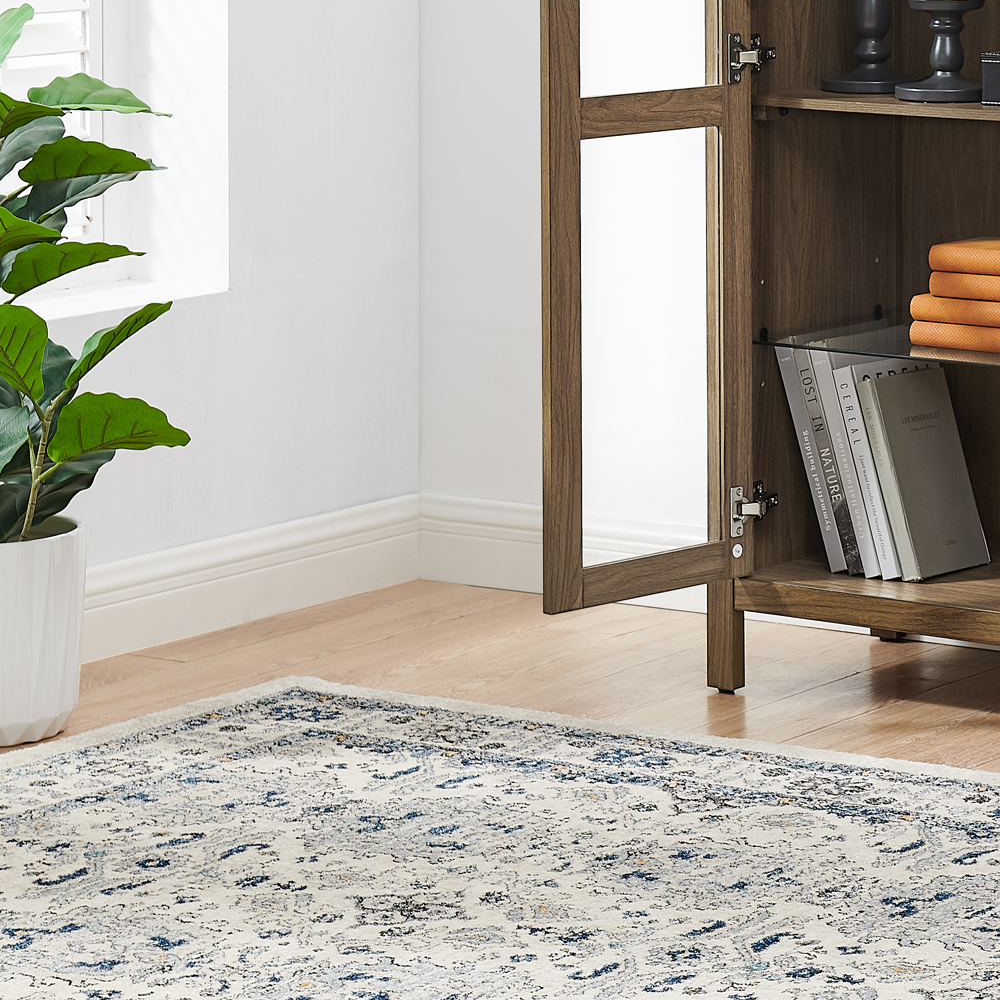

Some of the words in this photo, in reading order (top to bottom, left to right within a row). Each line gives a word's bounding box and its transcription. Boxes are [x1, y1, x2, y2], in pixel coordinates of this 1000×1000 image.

[800, 368, 818, 403] LOST
[812, 415, 825, 432] IN
[820, 448, 842, 503] NATURE
[901, 416, 911, 425] LES
[812, 473, 831, 531] Symmetrical
[836, 432, 858, 507] Hallucinations
[840, 383, 861, 445] CEREAL
[867, 490, 875, 508] collect
[874, 517, 884, 542] beautiful
[880, 542, 888, 560] things
[855, 508, 865, 539] Urban
